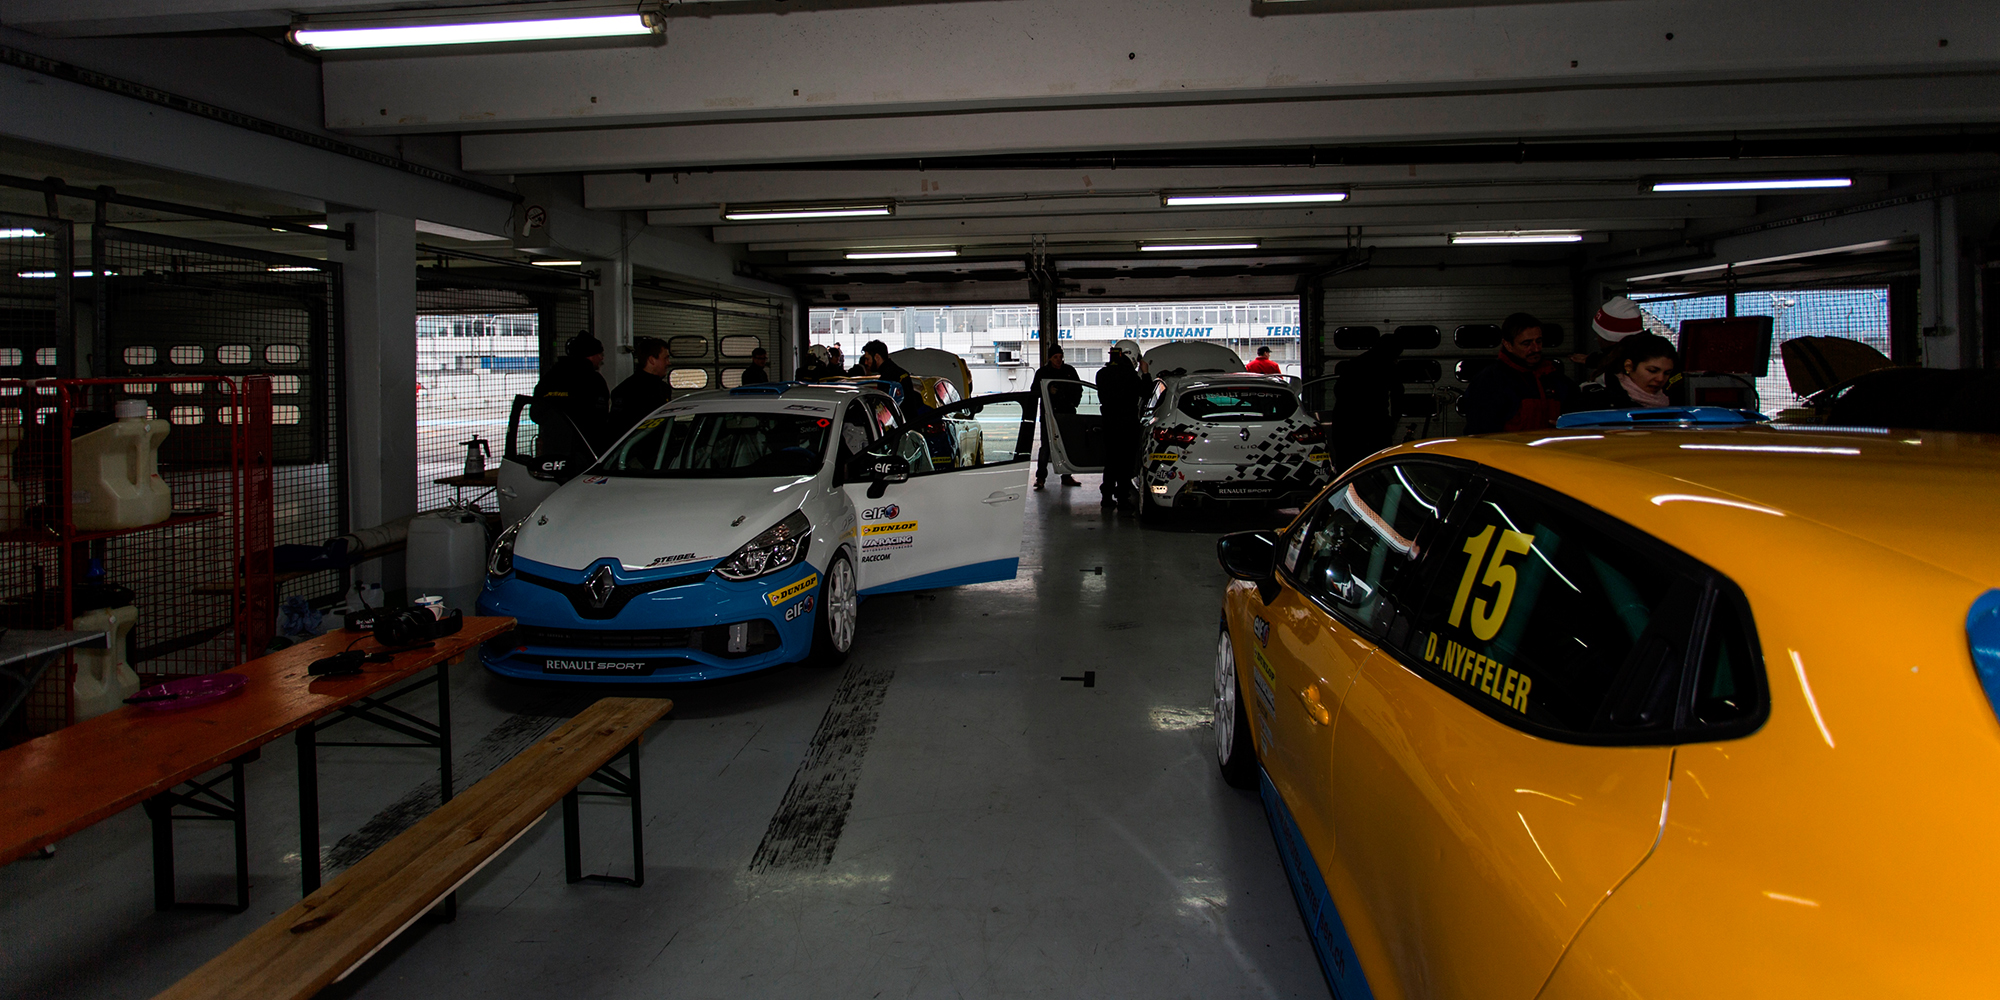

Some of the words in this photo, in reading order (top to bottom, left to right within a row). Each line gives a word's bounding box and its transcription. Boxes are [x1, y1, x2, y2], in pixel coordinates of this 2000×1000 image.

[1031, 329, 1072, 339] HEL
[1123, 327, 1213, 338] RESTAURANT
[1193, 391, 1240, 401] RENAULT
[637, 418, 665, 430] 28
[541, 460, 566, 471] elf
[874, 462, 892, 474] elf
[861, 507, 886, 520] elf
[872, 523, 916, 533] DUNLOP
[653, 552, 696, 563] STEIBEL
[862, 553, 891, 563] RACECOM
[1447, 523, 1536, 641] 15
[780, 577, 816, 599] DUNLOP
[784, 600, 804, 622] elf
[546, 660, 597, 671] RENAULT
[597, 662, 645, 670] SPORT
[1424, 631, 1440, 665] D.
[1442, 639, 1533, 715] NYFFELER
